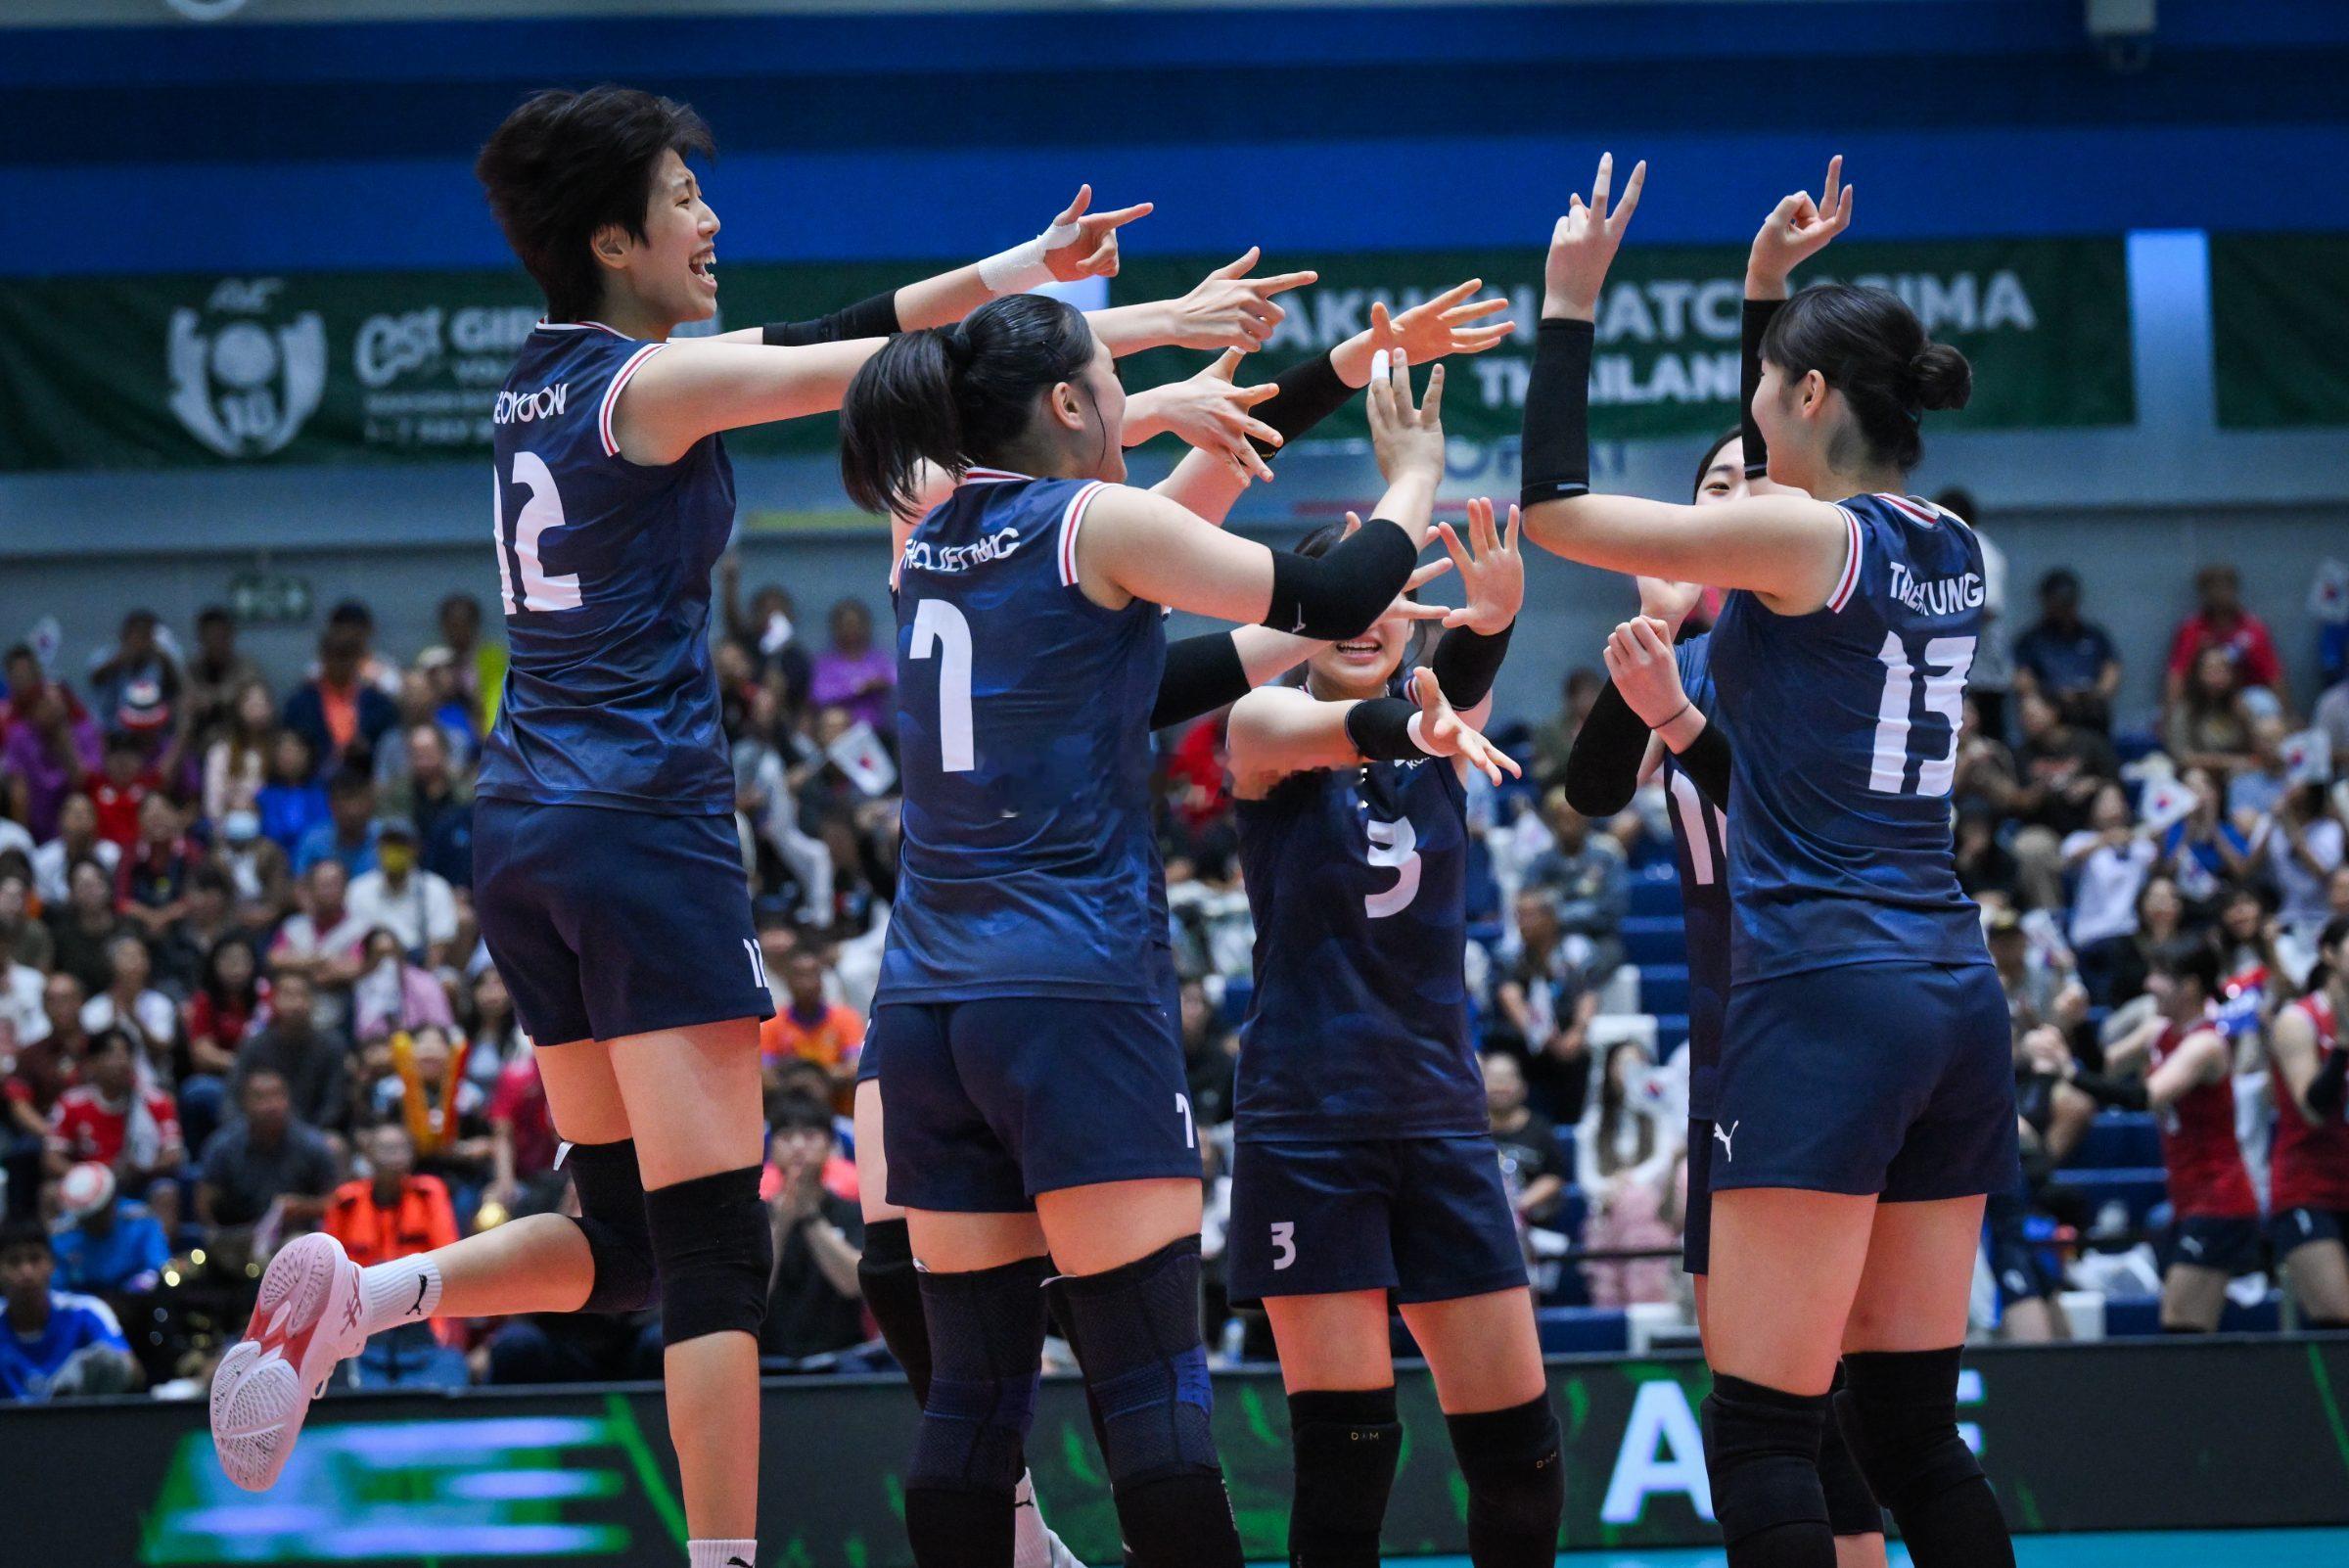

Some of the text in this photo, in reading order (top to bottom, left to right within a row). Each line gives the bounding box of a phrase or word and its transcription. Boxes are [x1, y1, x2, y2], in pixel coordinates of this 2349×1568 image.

[1595, 270, 2040, 342] ATCIMA
[1472, 353, 1743, 409] THILAN
[493, 450, 583, 616] 12
[908, 598, 975, 773] 7
[1868, 629, 1977, 797] 13
[1364, 815, 1422, 919] 3
[1270, 1221, 1297, 1270] 3
